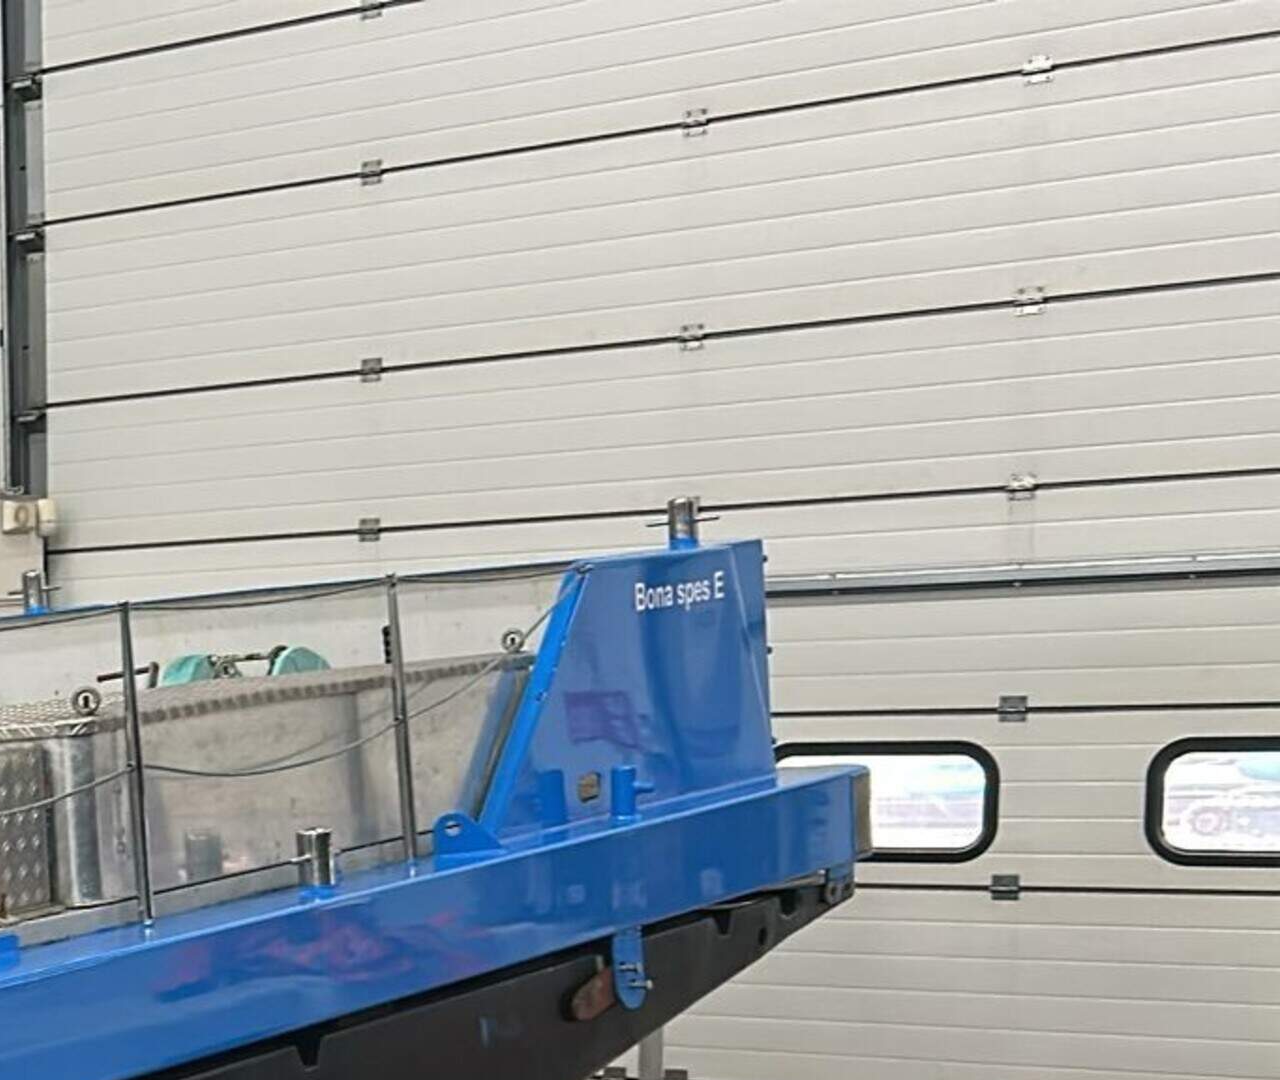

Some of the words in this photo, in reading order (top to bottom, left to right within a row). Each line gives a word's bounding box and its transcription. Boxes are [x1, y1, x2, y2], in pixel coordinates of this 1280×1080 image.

[634, 581, 674, 612] Bona
[677, 578, 711, 611] spes
[714, 571, 725, 599] E
